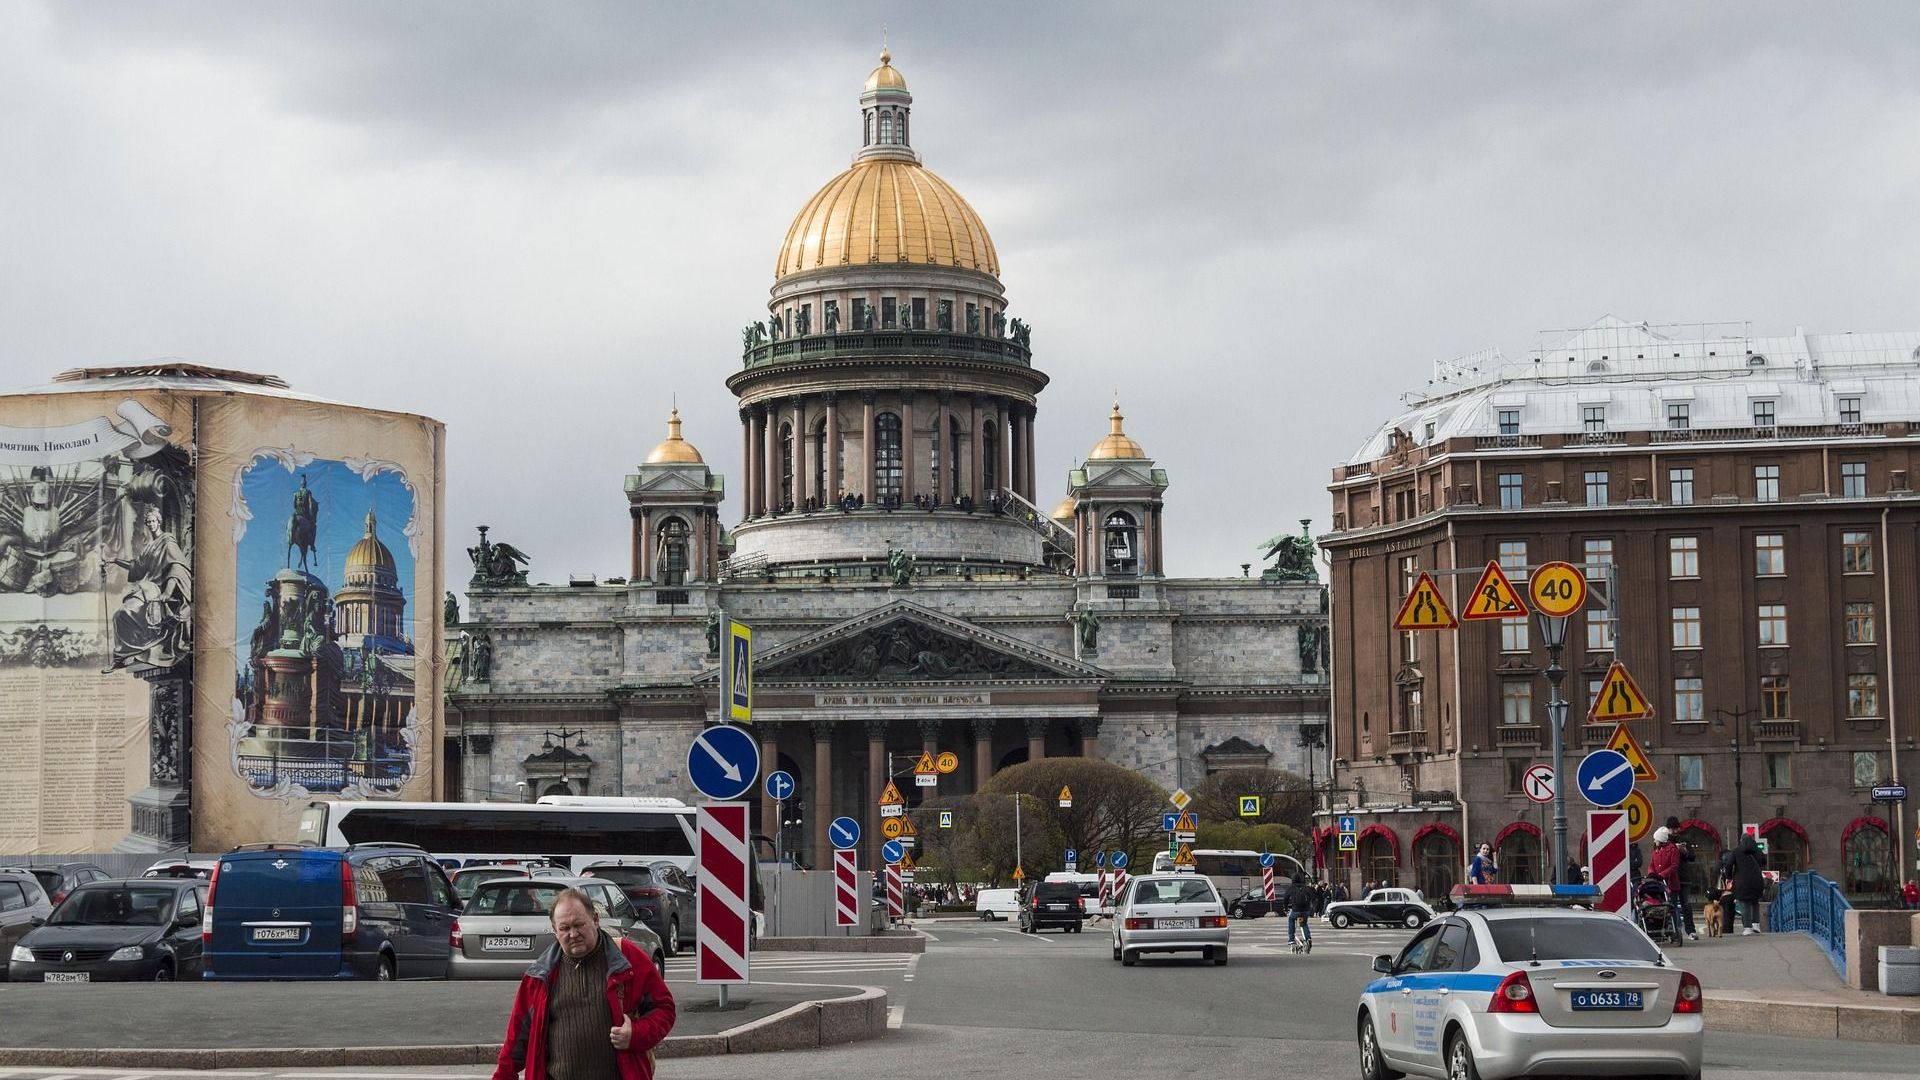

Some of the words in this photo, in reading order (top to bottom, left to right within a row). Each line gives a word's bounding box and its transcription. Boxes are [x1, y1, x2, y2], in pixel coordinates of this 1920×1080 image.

[44, 438, 91, 452] Николаю
[1349, 546, 1370, 559] HOTEL
[1541, 578, 1573, 601] 40
[941, 758, 954, 767] 40
[885, 823, 899, 833] 40
[1067, 850, 1075, 861] P
[1590, 993, 1621, 1006] 0633
[1626, 992, 1639, 1002] 78
